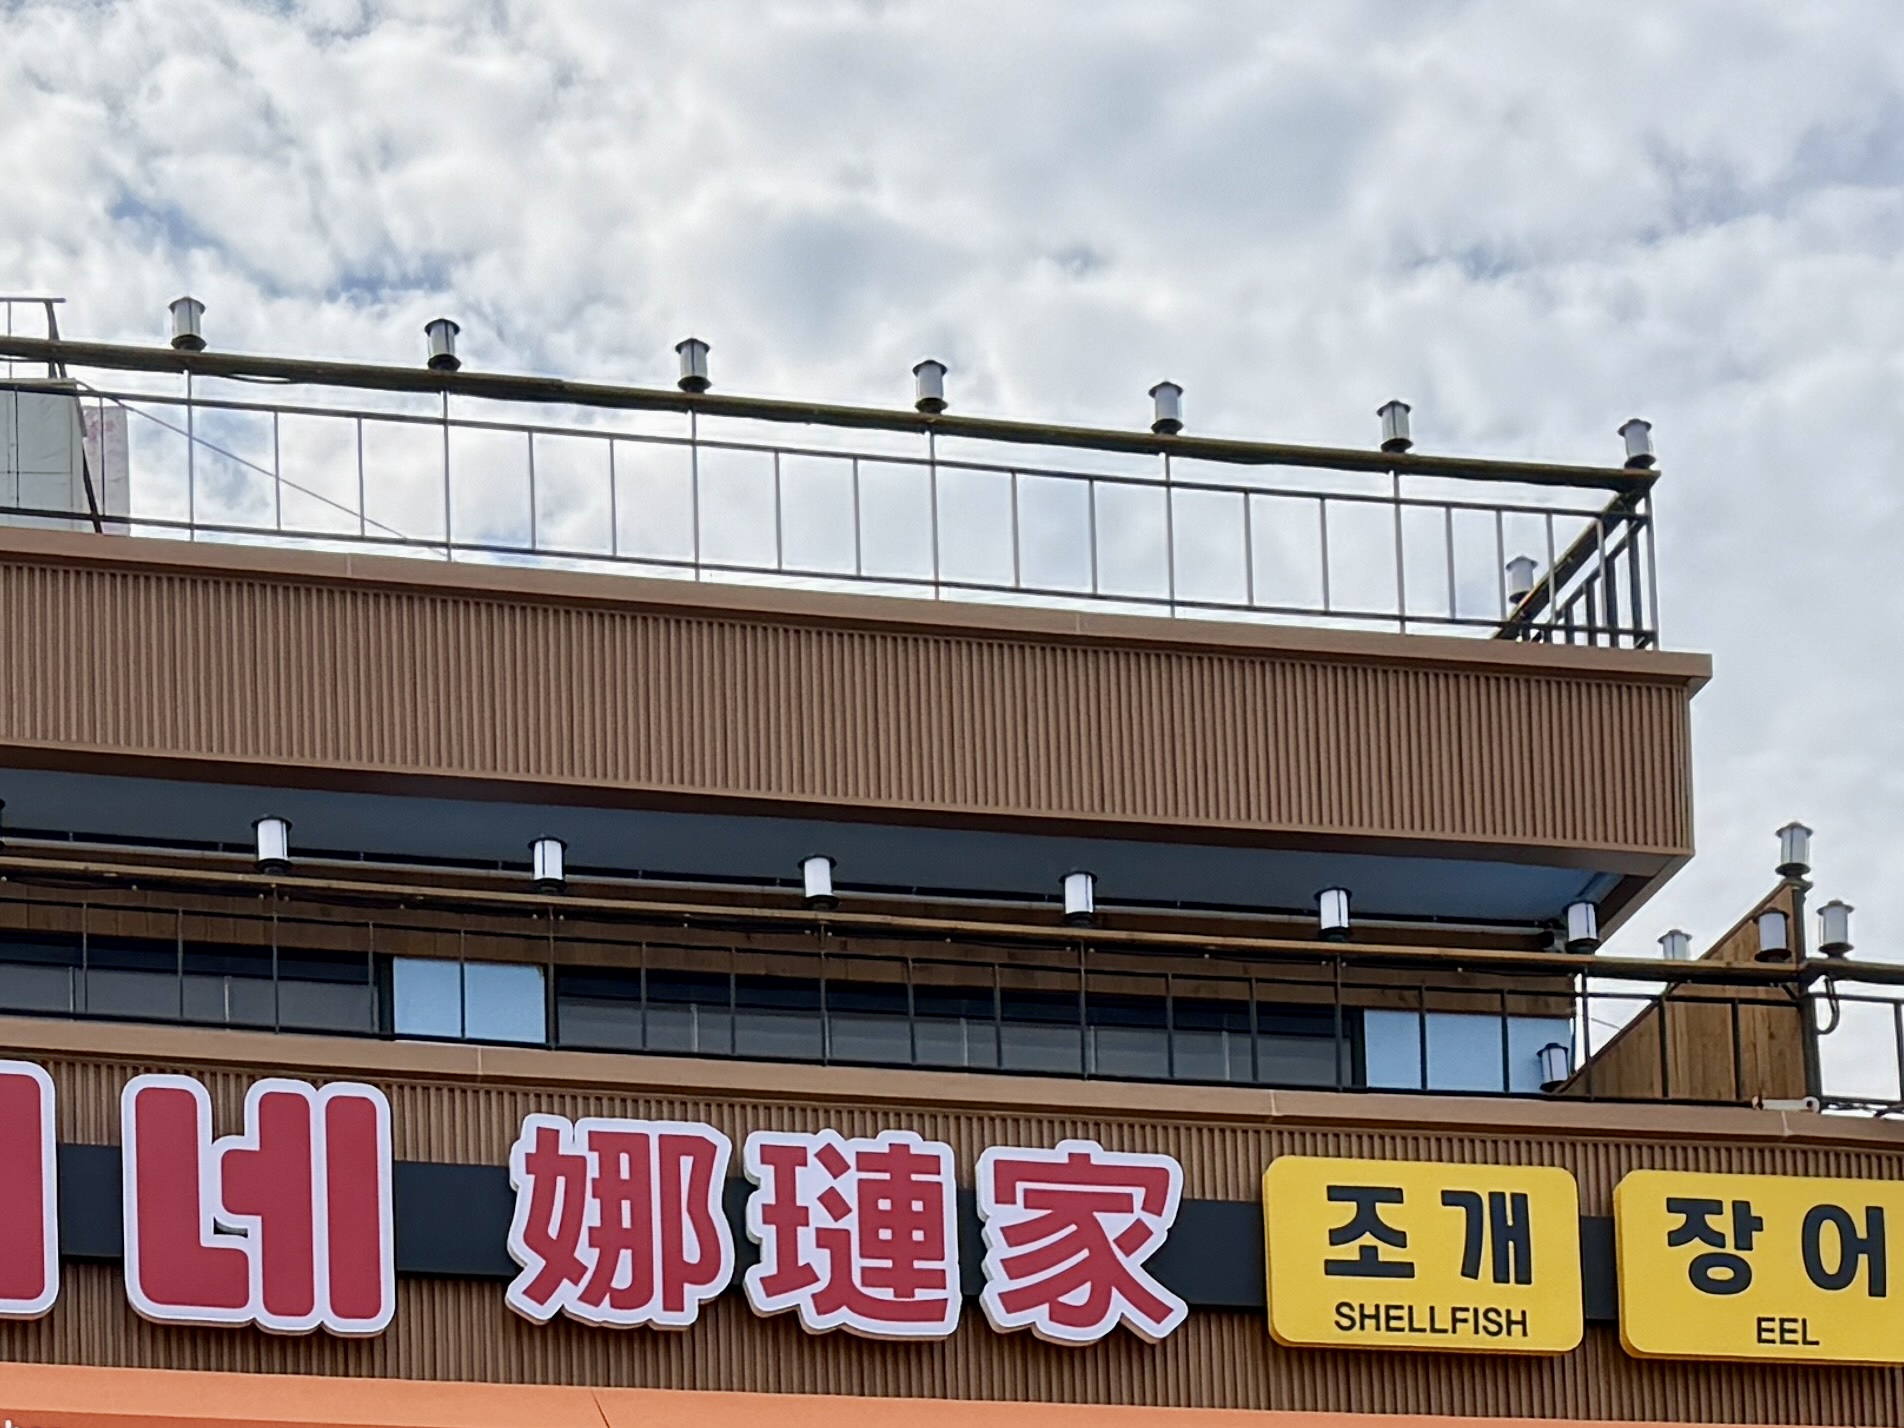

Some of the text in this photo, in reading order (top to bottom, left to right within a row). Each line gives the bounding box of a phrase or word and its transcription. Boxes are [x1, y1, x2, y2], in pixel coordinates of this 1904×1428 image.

[1322, 1181, 1535, 1289] 조개
[1666, 1194, 1886, 1300] 장어
[1332, 1300, 1530, 1341] SHELLFISH
[1754, 1316, 1821, 1347] EEL
